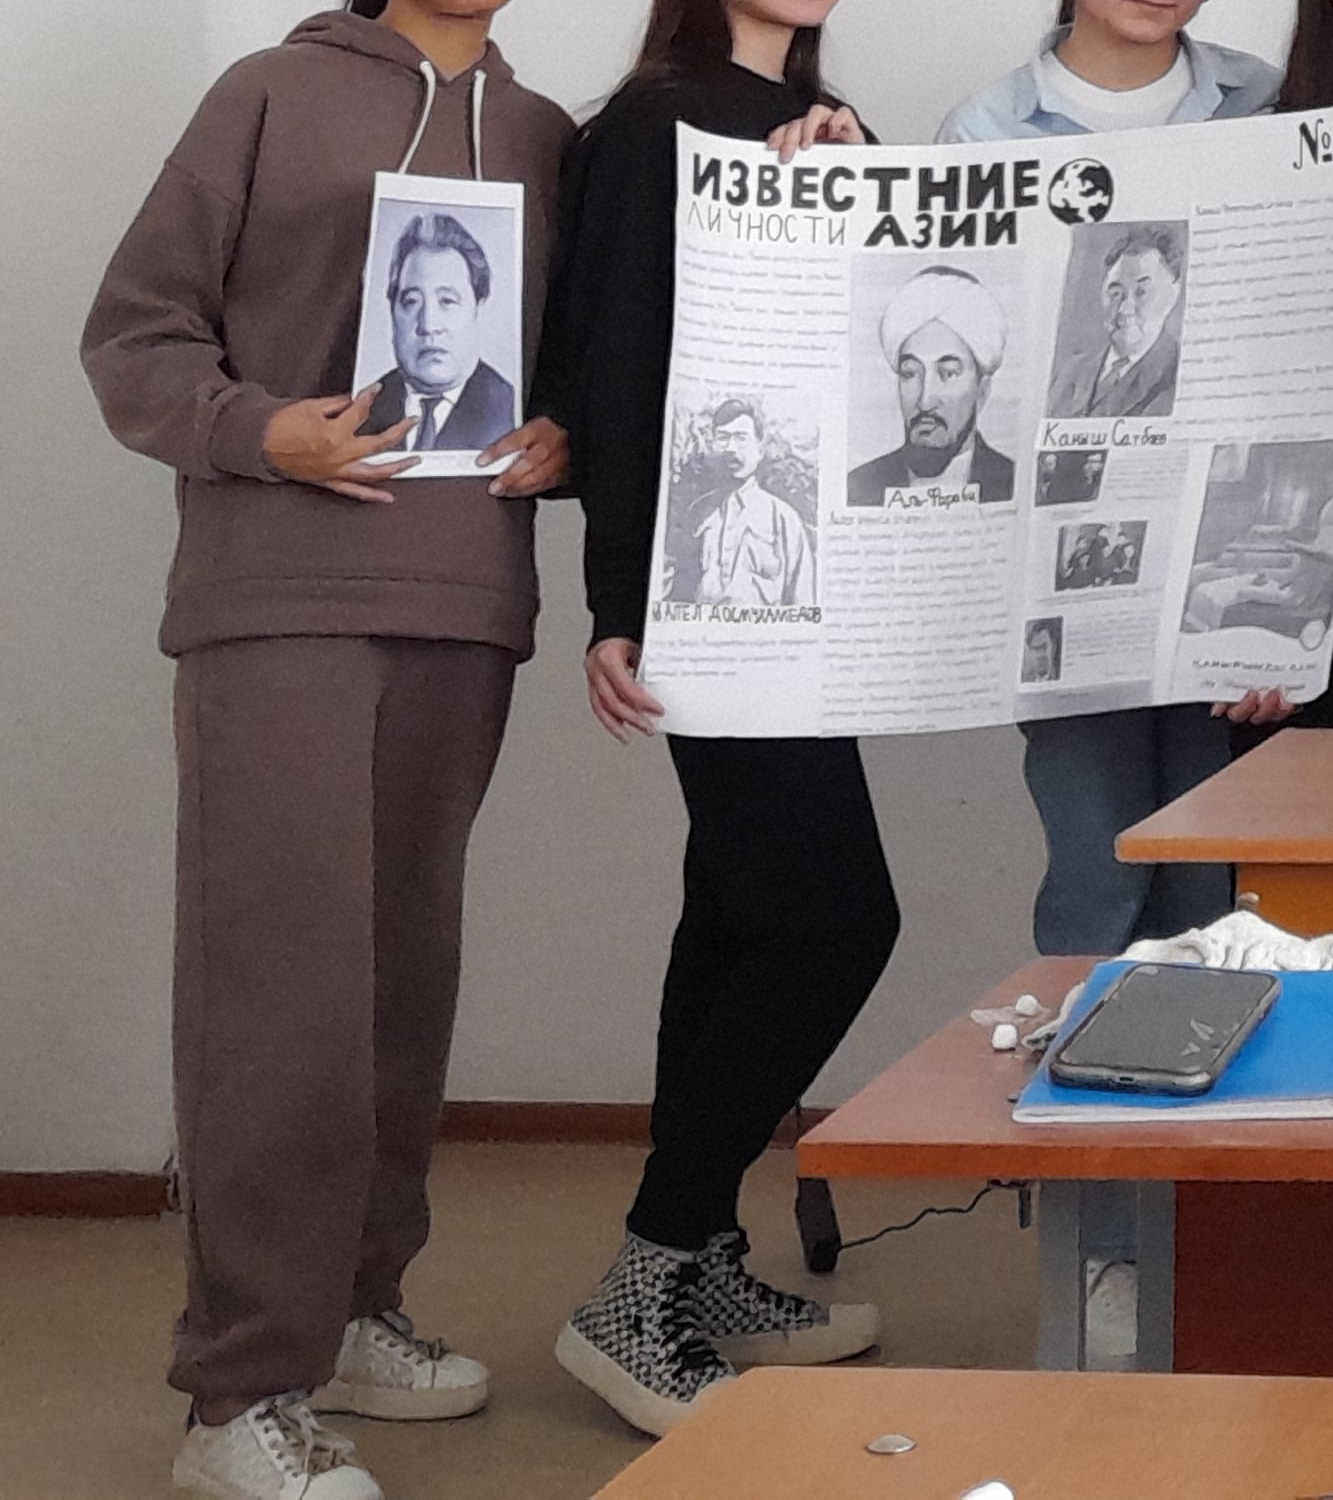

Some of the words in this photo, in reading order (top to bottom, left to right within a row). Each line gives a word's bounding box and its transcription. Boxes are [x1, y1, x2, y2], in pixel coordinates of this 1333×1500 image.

[692, 151, 1041, 213] ИЗВЕСТНИЕ
[686, 200, 847, 247] ЛИЧНОСТИ
[863, 210, 1019, 250] АЗИИ
